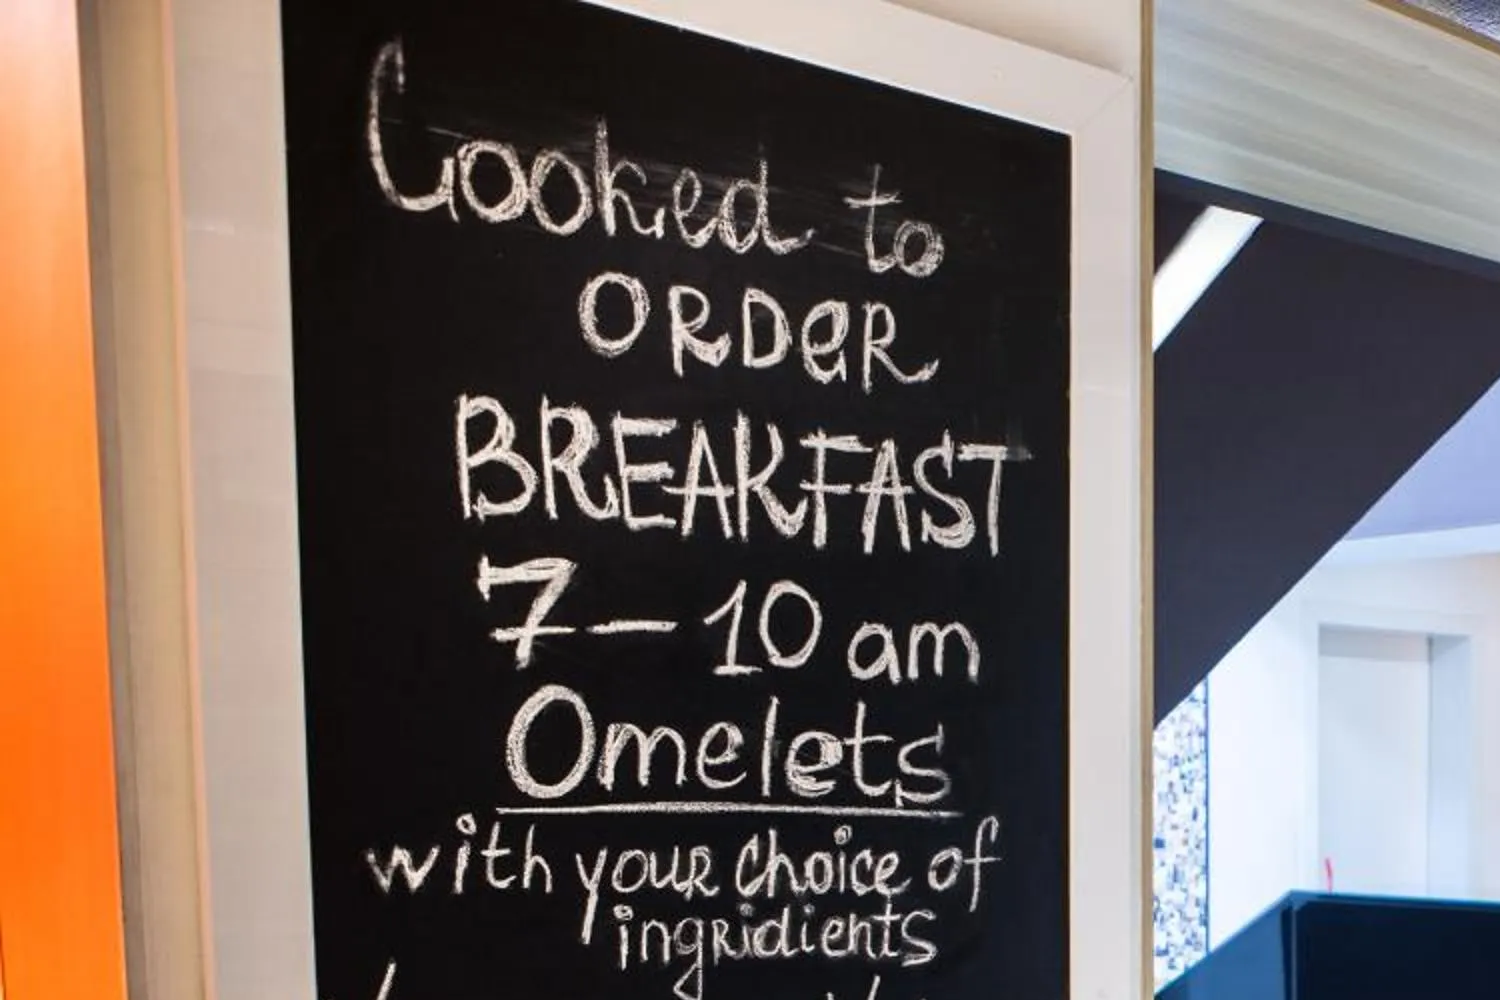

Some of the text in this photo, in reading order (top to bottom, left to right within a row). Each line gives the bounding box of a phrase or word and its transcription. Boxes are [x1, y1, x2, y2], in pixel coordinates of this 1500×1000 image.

[367, 36, 946, 277] Cooked to
[455, 394, 1032, 557] BREAKFAST
[847, 621, 982, 684] am
[506, 684, 952, 808] Omelets
[366, 814, 553, 894] with
[927, 816, 1001, 912] of
